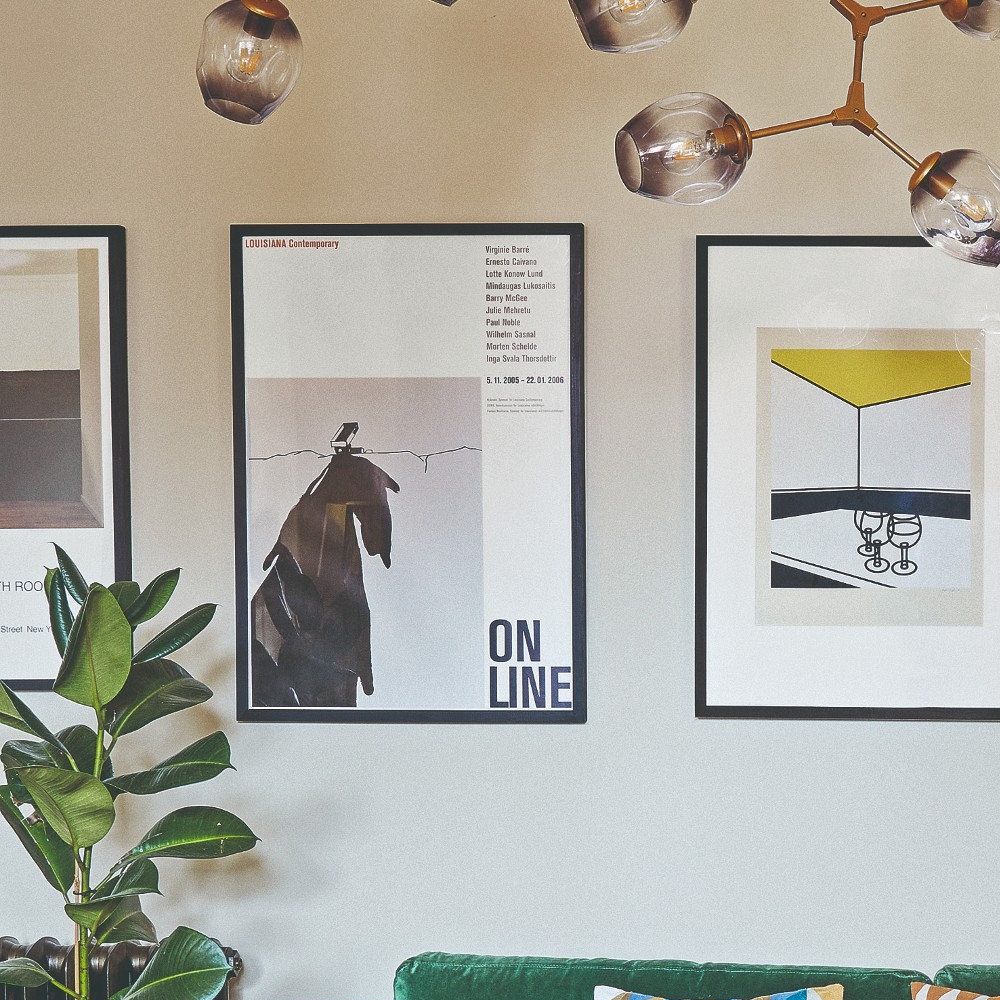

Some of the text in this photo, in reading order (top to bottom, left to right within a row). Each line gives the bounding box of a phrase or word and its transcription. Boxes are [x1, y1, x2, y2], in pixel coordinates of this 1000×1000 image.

[245, 239, 340, 250] LOUISIANA Contemporary
[485, 245, 510, 255] Virginie
[485, 257, 537, 266] Ernesto Caivano
[485, 270, 543, 278] Lotte Konow Lund
[485, 282, 521, 291] Mindaugas
[485, 294, 528, 303] Barry McGee
[485, 306, 531, 314] Julie Mehretu
[485, 318, 521, 326] Paul Noble
[485, 330, 536, 338] Wilhelm Sasnal
[486, 342, 538, 350] Morten Schelde
[486, 355, 501, 364] Inga
[502, 354, 520, 363] Svala
[503, 376, 520, 384] 2005
[547, 376, 564, 384] 2006
[15, 580, 43, 592] ROO
[0, 625, 23, 633] Street
[26, 625, 44, 633] New
[489, 619, 541, 662] ON
[489, 666, 572, 708] LINE
